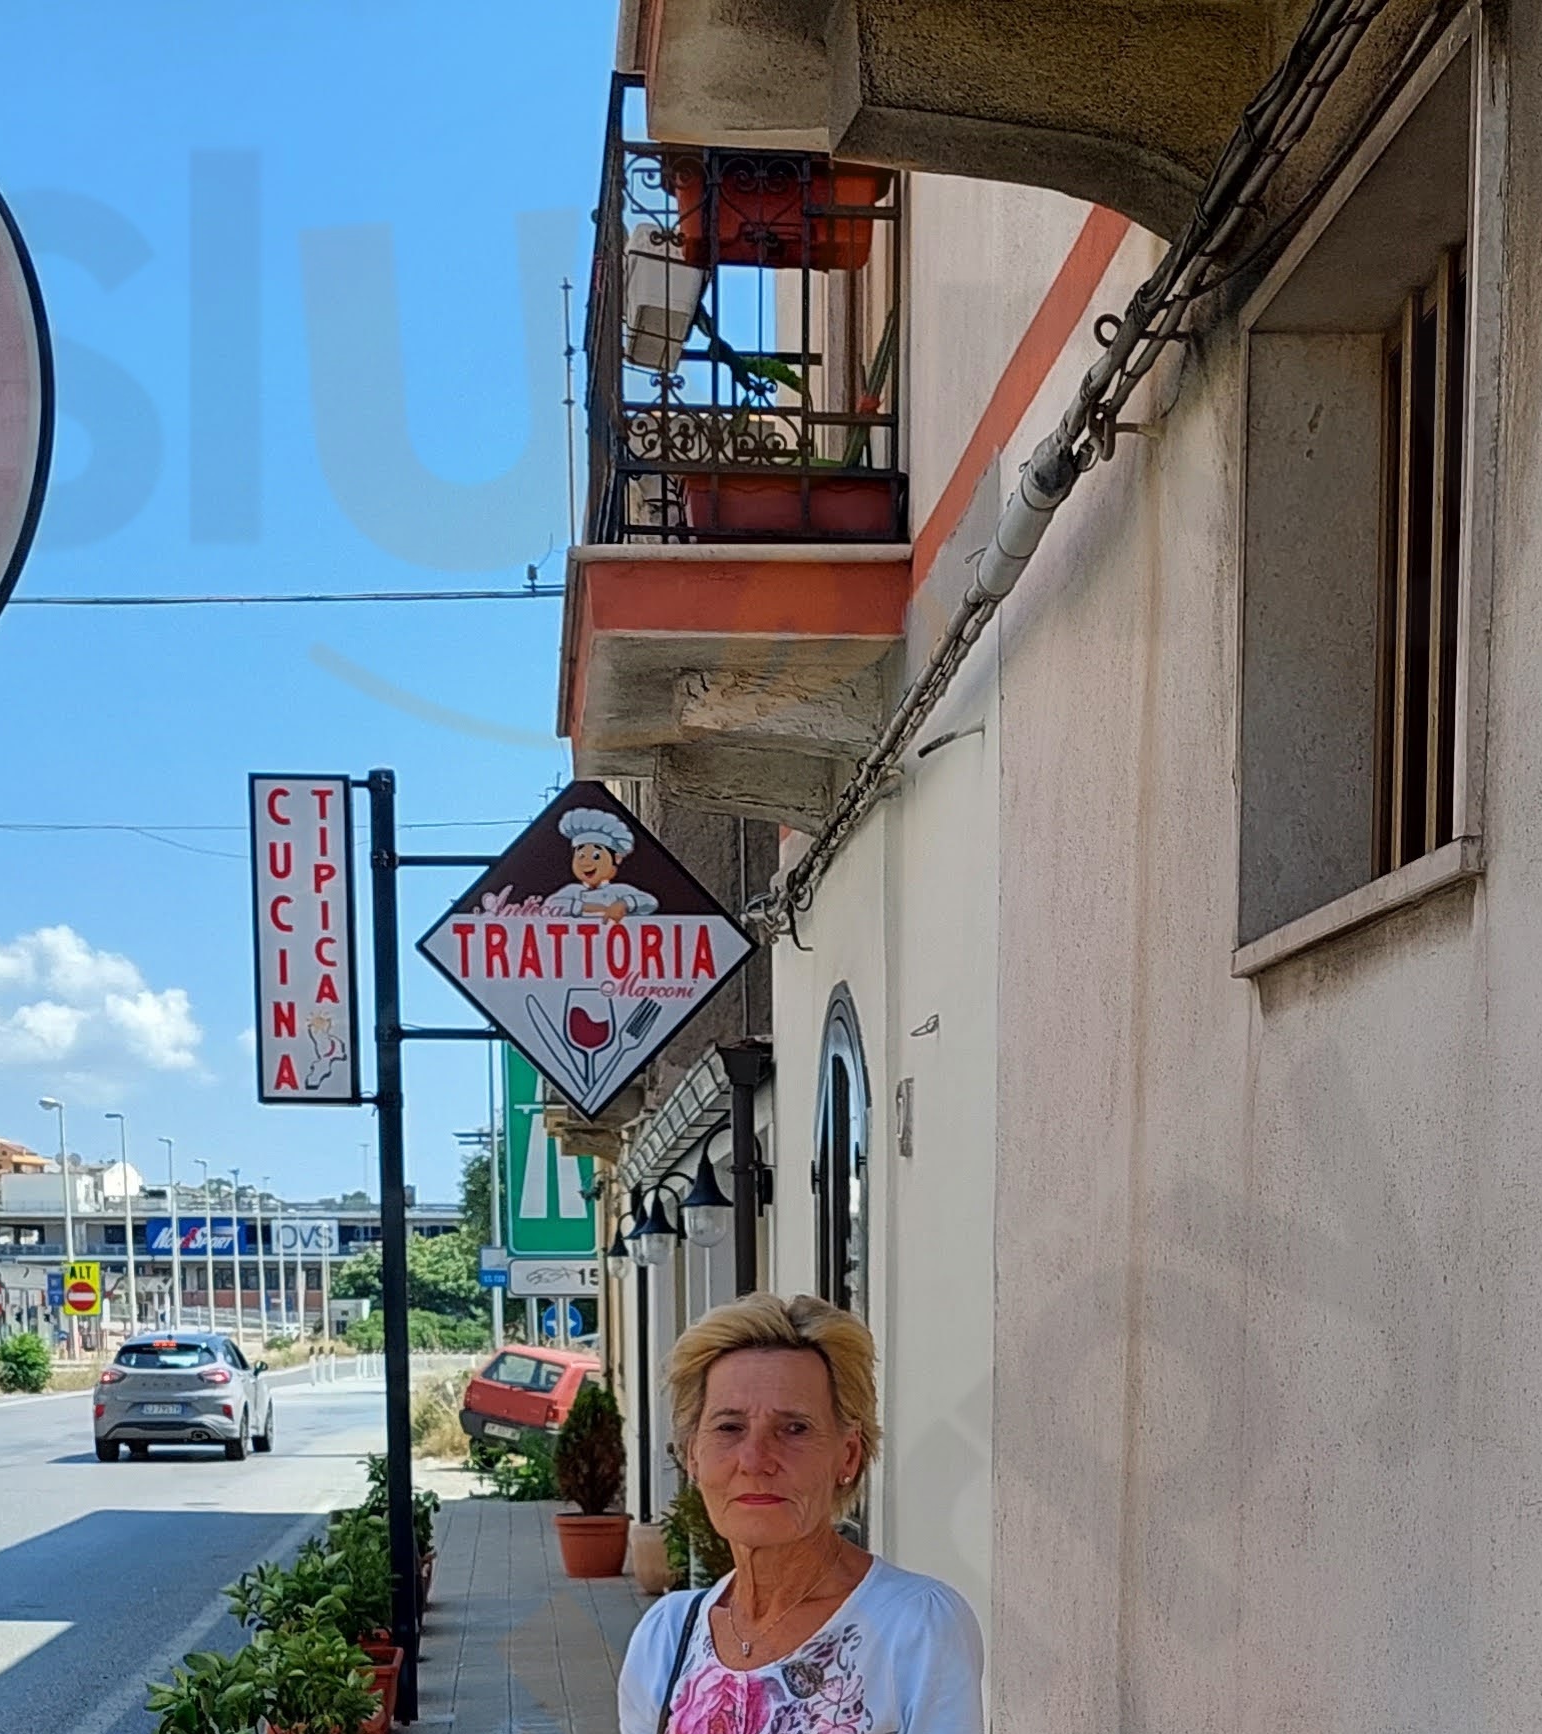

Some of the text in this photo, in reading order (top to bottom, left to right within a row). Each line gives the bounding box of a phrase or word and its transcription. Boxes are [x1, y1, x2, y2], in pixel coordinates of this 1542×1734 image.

[311, 789, 340, 1004] TIPICA
[473, 885, 565, 918] Antica
[266, 787, 299, 1091] CUCINA
[452, 922, 717, 980] TRATTORIA
[599, 971, 698, 999] Marconi
[276, 1224, 334, 1249] OVS
[69, 1265, 92, 1280] ALT
